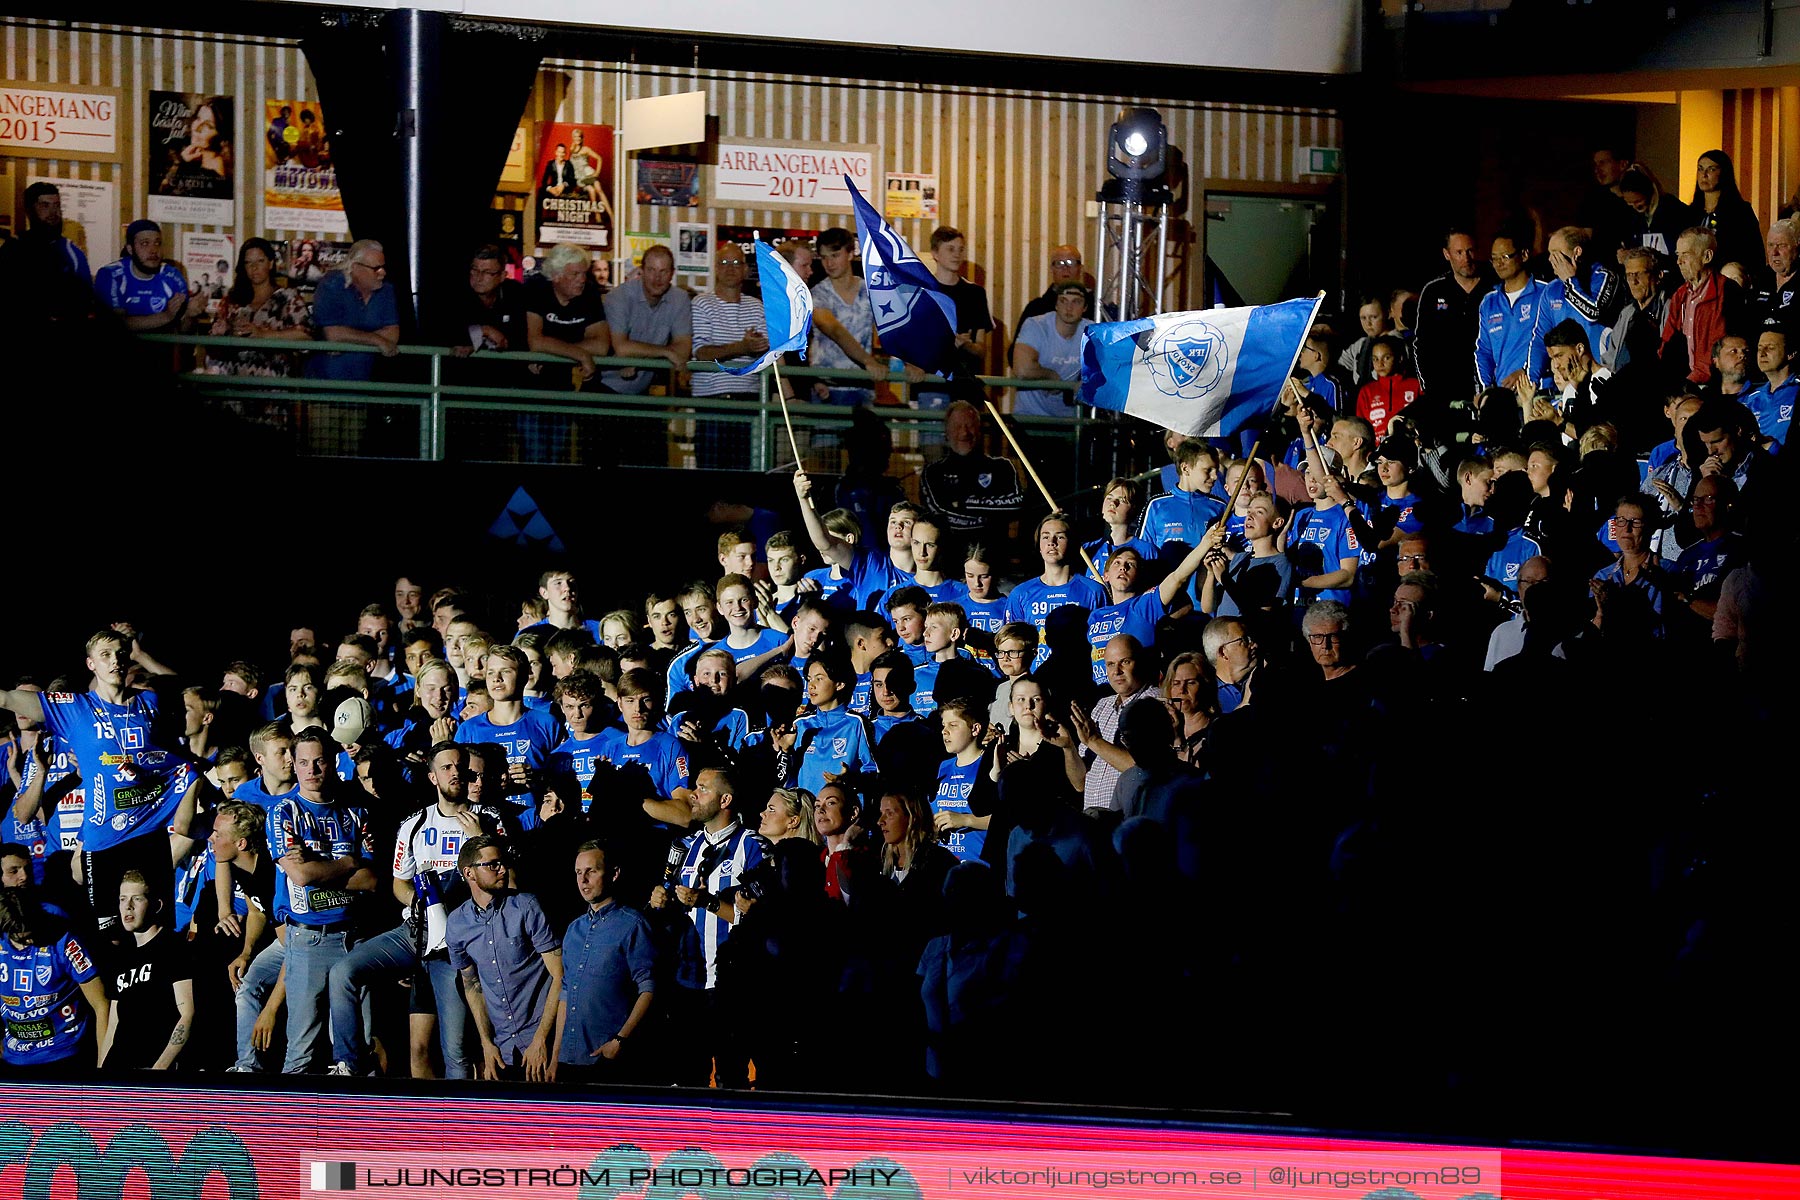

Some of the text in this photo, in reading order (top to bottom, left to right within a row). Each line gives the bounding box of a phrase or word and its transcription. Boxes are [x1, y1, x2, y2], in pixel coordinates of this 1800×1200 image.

[0, 118, 56, 144] 2015
[720, 152, 867, 177] ARRANGEMANG
[769, 177, 818, 198] 2017
[542, 198, 605, 212] CHRISTMAS
[557, 211, 592, 222] NIGHT
[1031, 601, 1047, 615] 39
[1089, 622, 1100, 635] 28
[93, 721, 115, 739] 15
[422, 827, 437, 846] 10
[395, 840, 405, 871] MAXI
